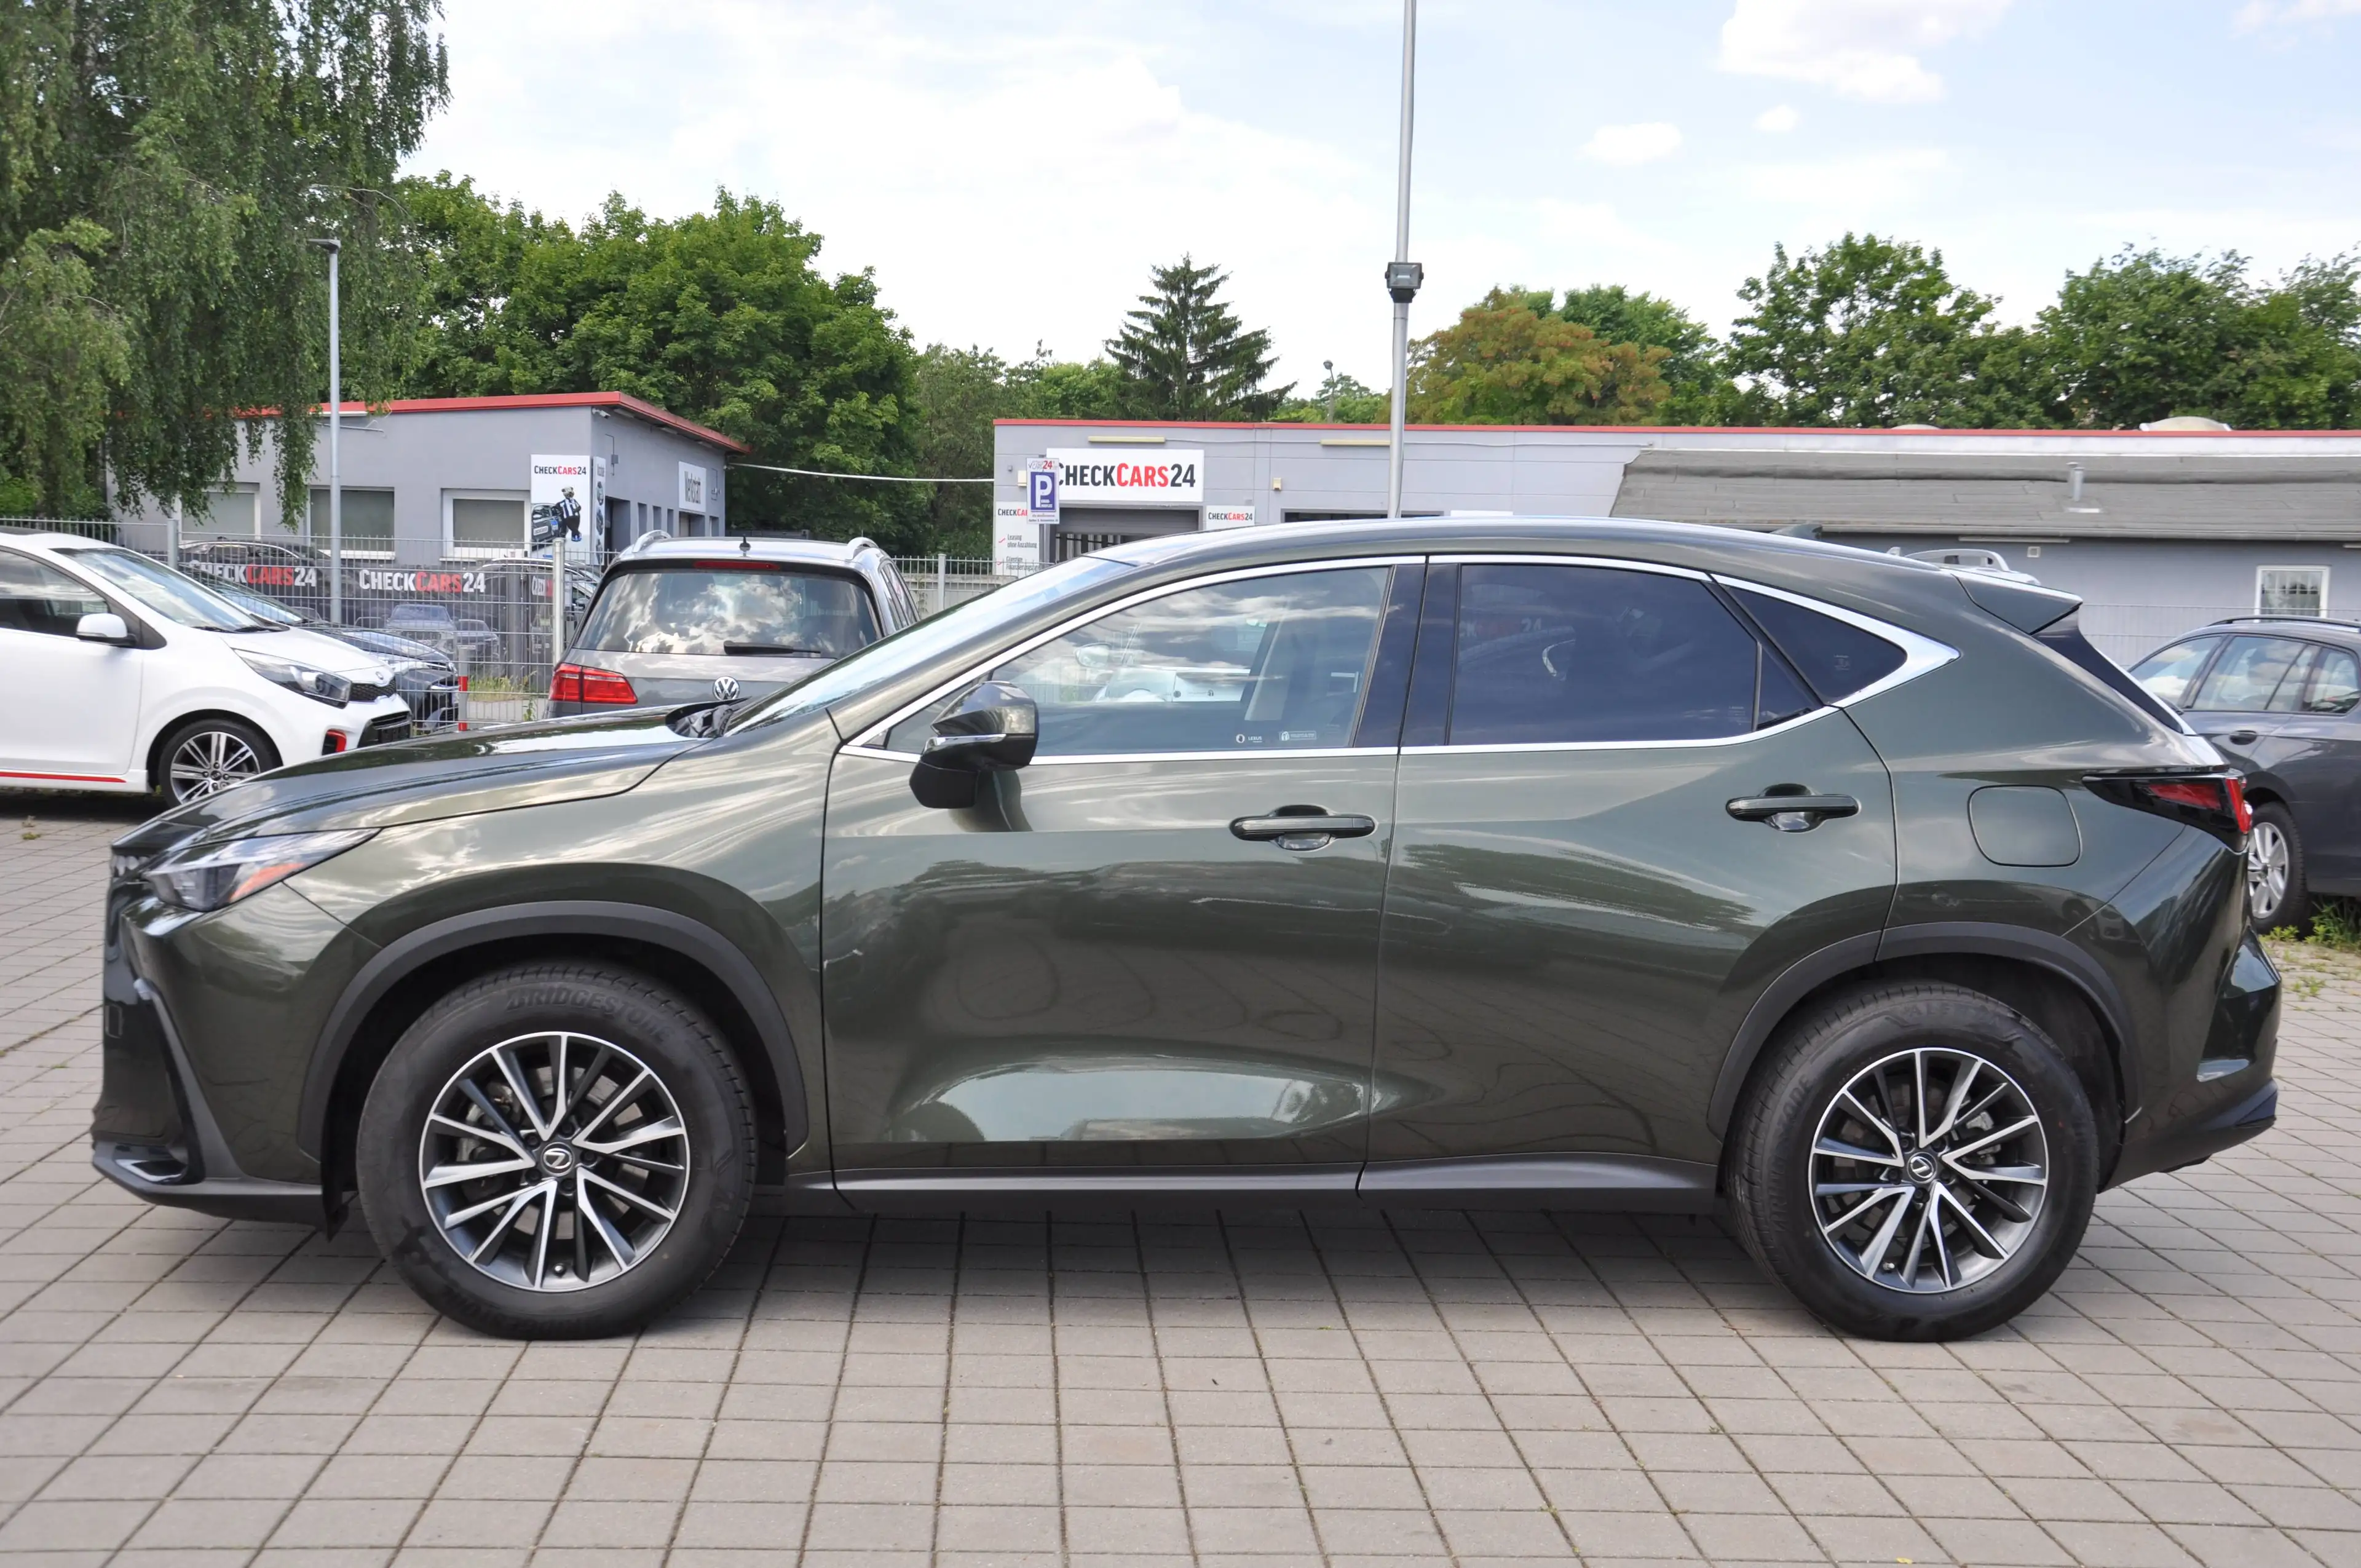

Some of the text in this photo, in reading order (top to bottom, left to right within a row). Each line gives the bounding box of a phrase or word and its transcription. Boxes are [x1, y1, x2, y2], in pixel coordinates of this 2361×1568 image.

[534, 465, 587, 475] CHECKCARS24
[1035, 475, 1053, 508] P
[359, 569, 486, 592] CHECKCARS24
